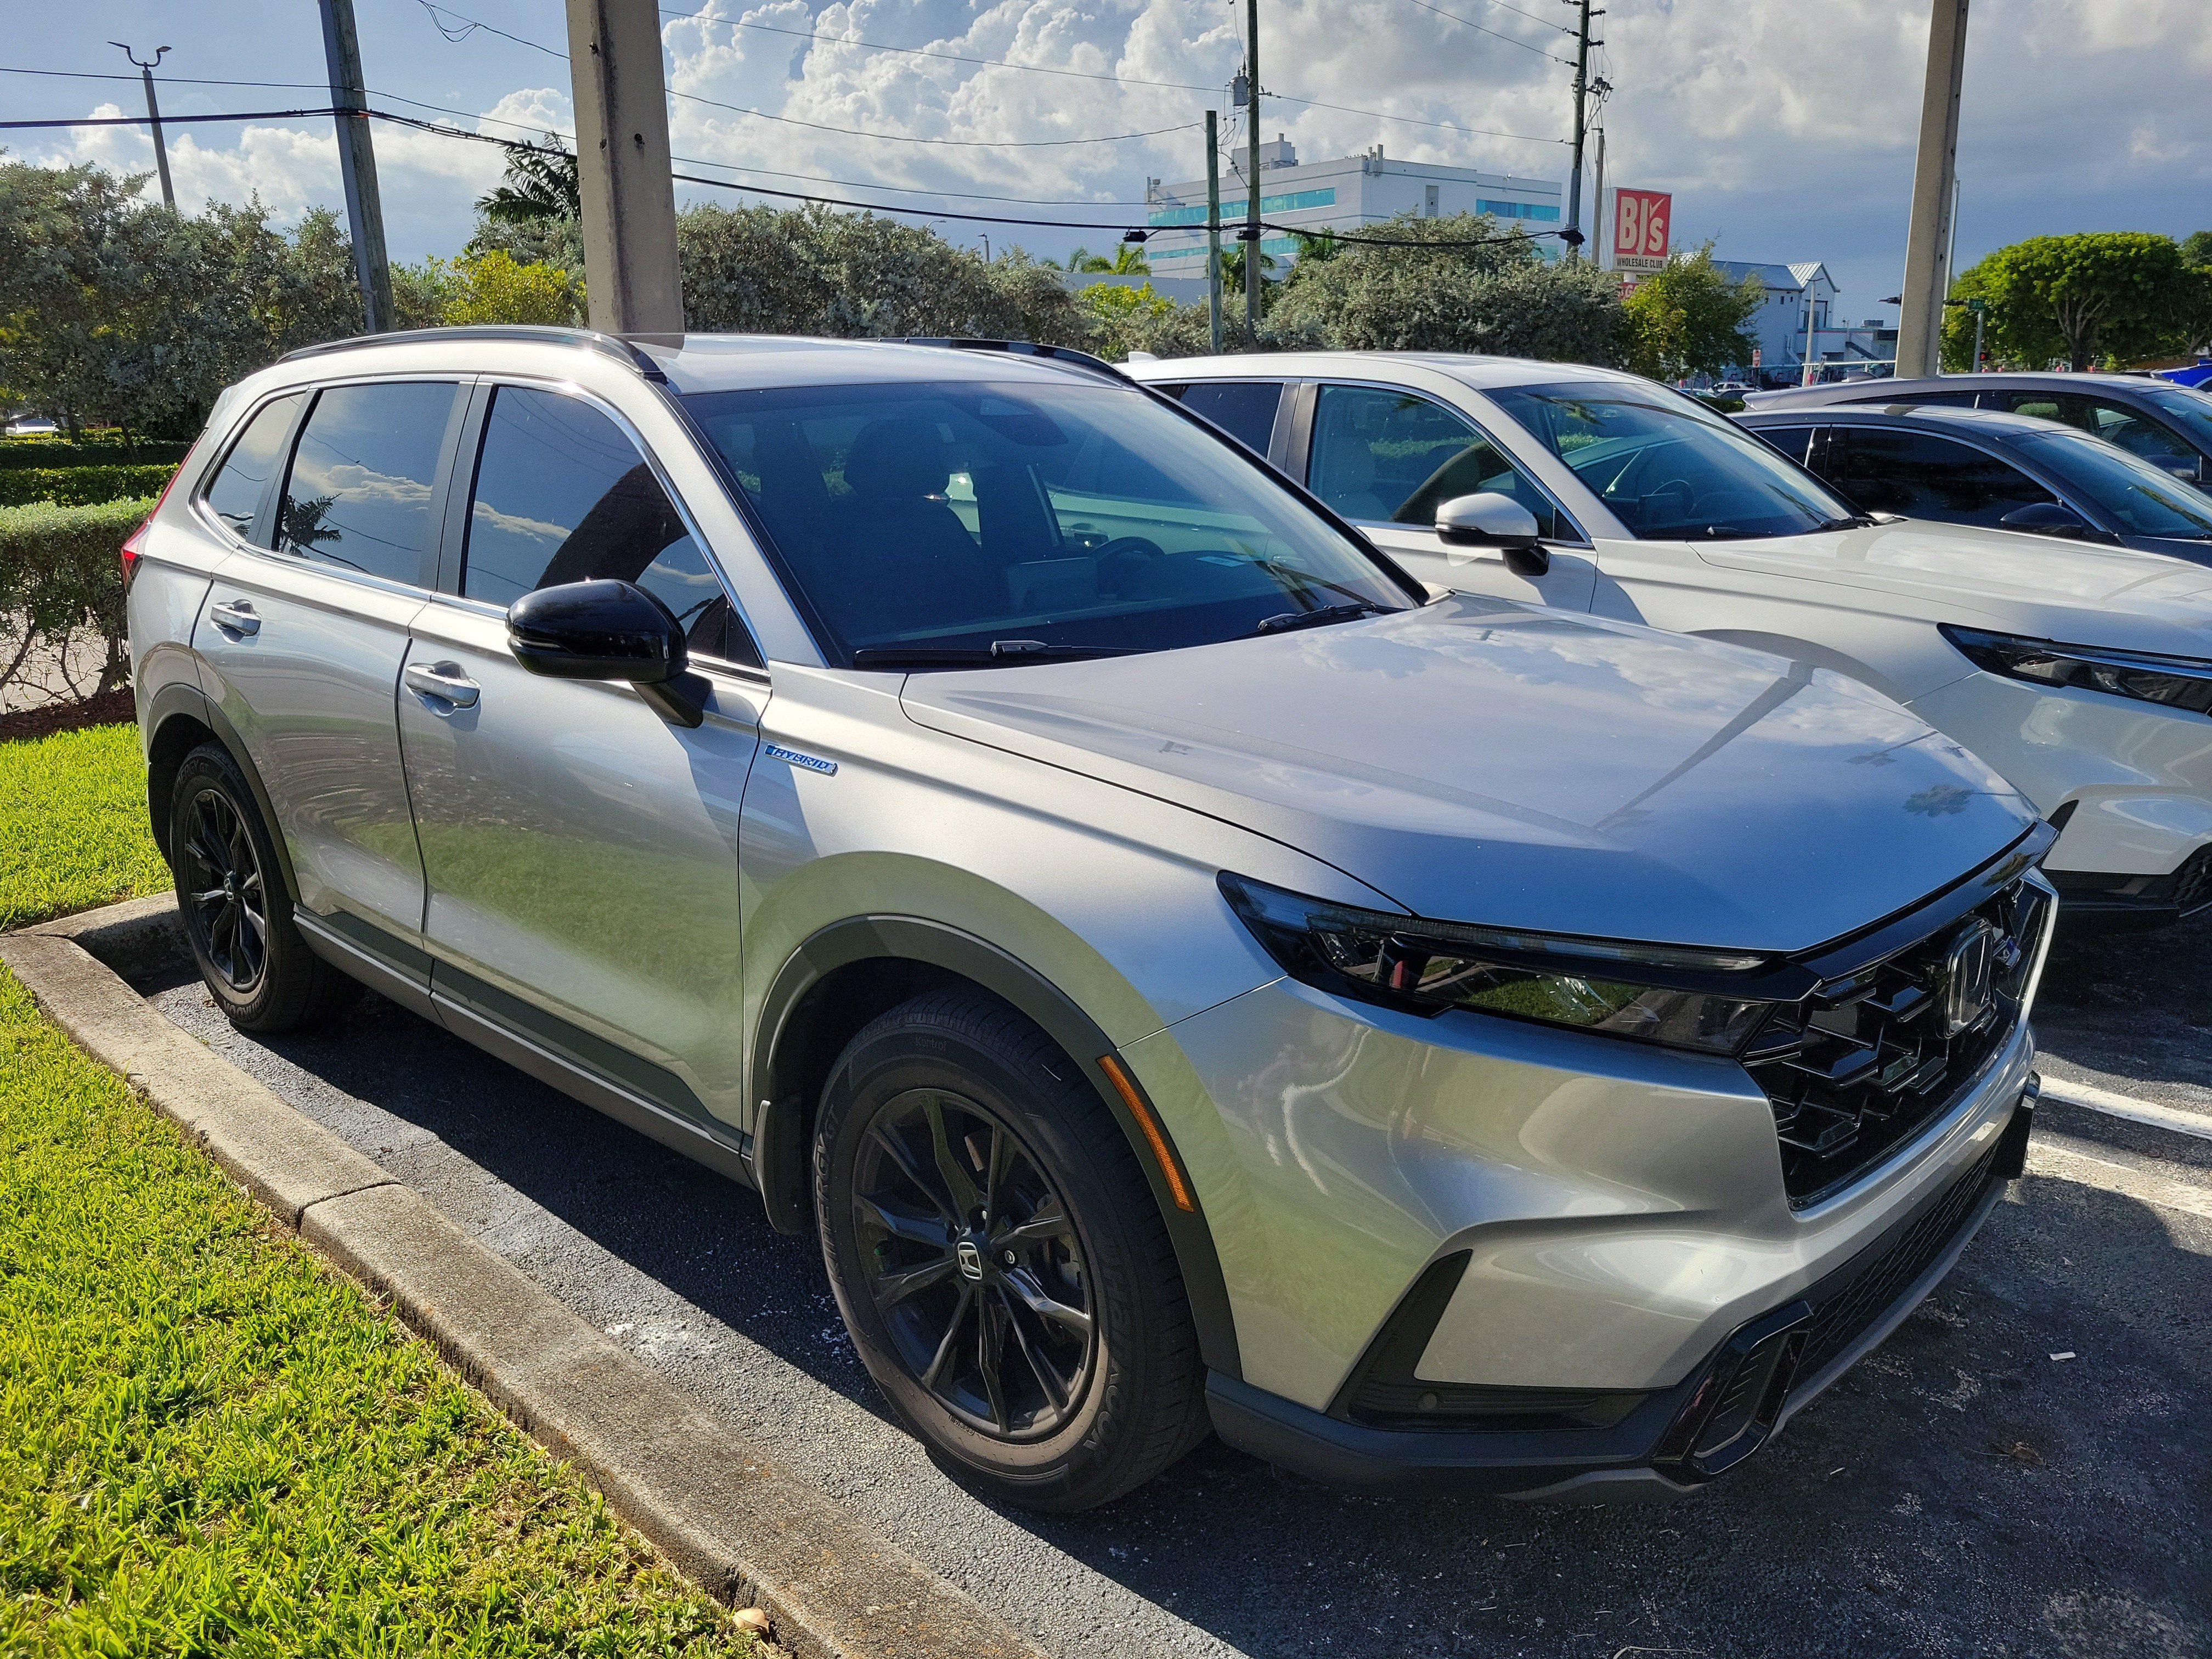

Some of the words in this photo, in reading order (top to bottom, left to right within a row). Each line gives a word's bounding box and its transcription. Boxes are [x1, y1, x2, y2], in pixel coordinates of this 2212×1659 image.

[1619, 196, 1666, 255] BJ's
[1617, 257, 1648, 268] WHOLESALE
[1649, 259, 1663, 269] CLUB
[771, 746, 831, 770] HYBRID
